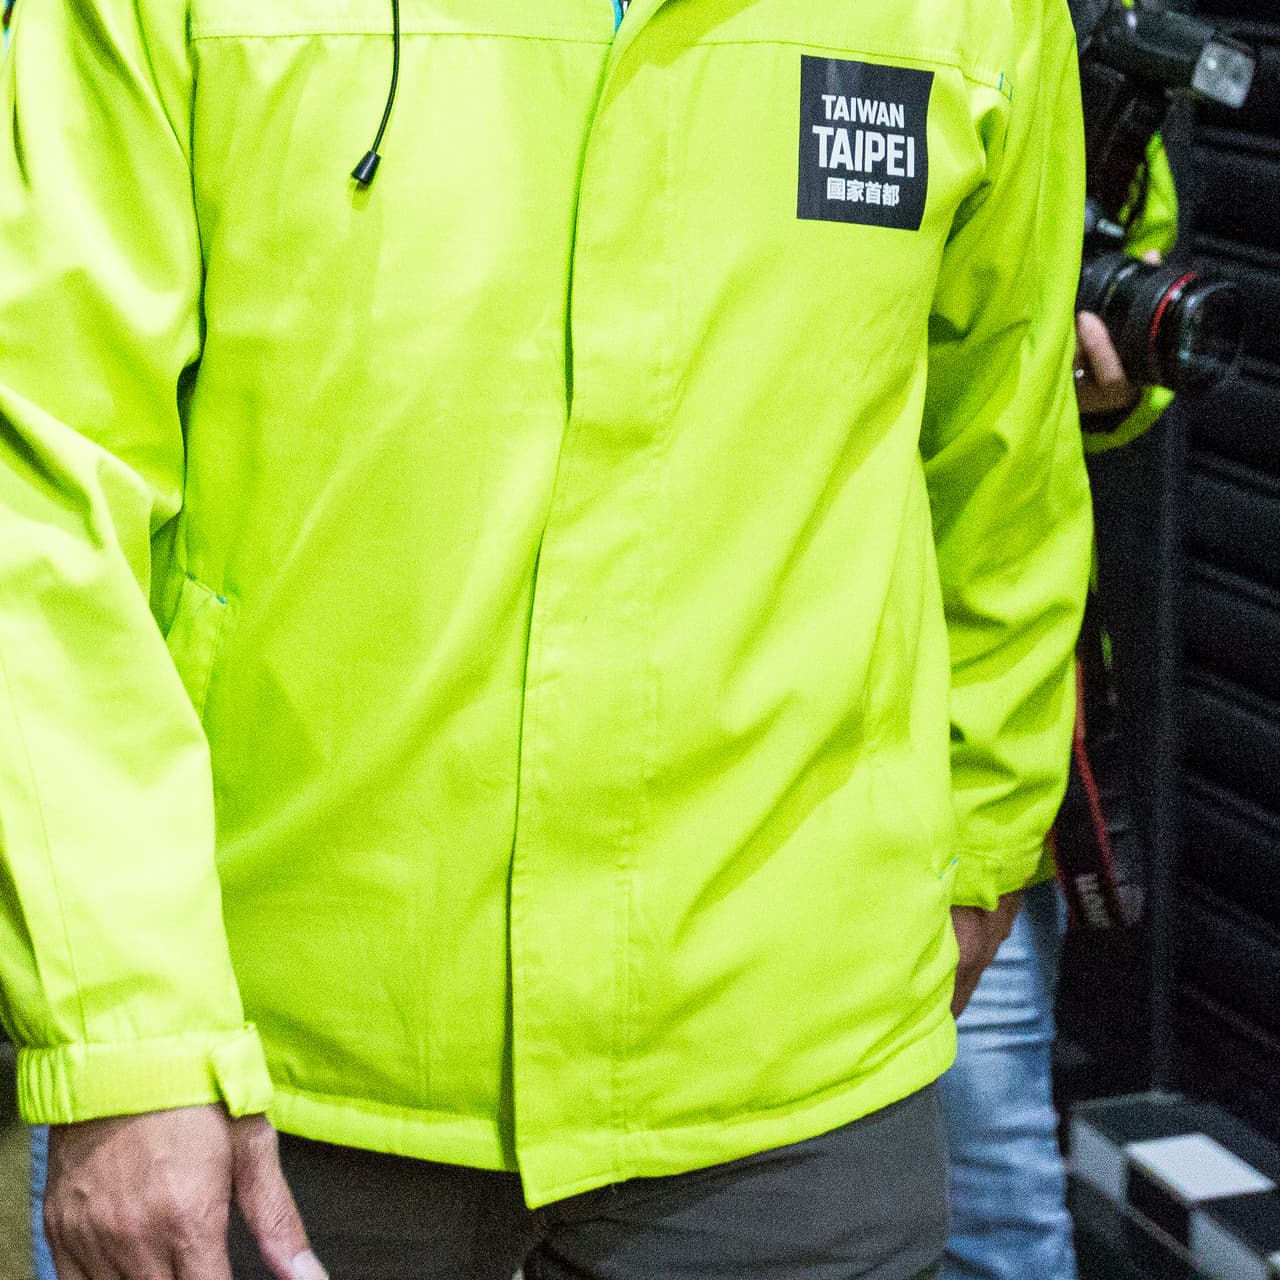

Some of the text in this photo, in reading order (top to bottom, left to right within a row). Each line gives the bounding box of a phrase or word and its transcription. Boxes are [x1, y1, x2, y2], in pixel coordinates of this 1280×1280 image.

[821, 94, 905, 129] TAIWAN
[812, 125, 915, 178] TAIPEI
[826, 176, 900, 207] 國家首都
